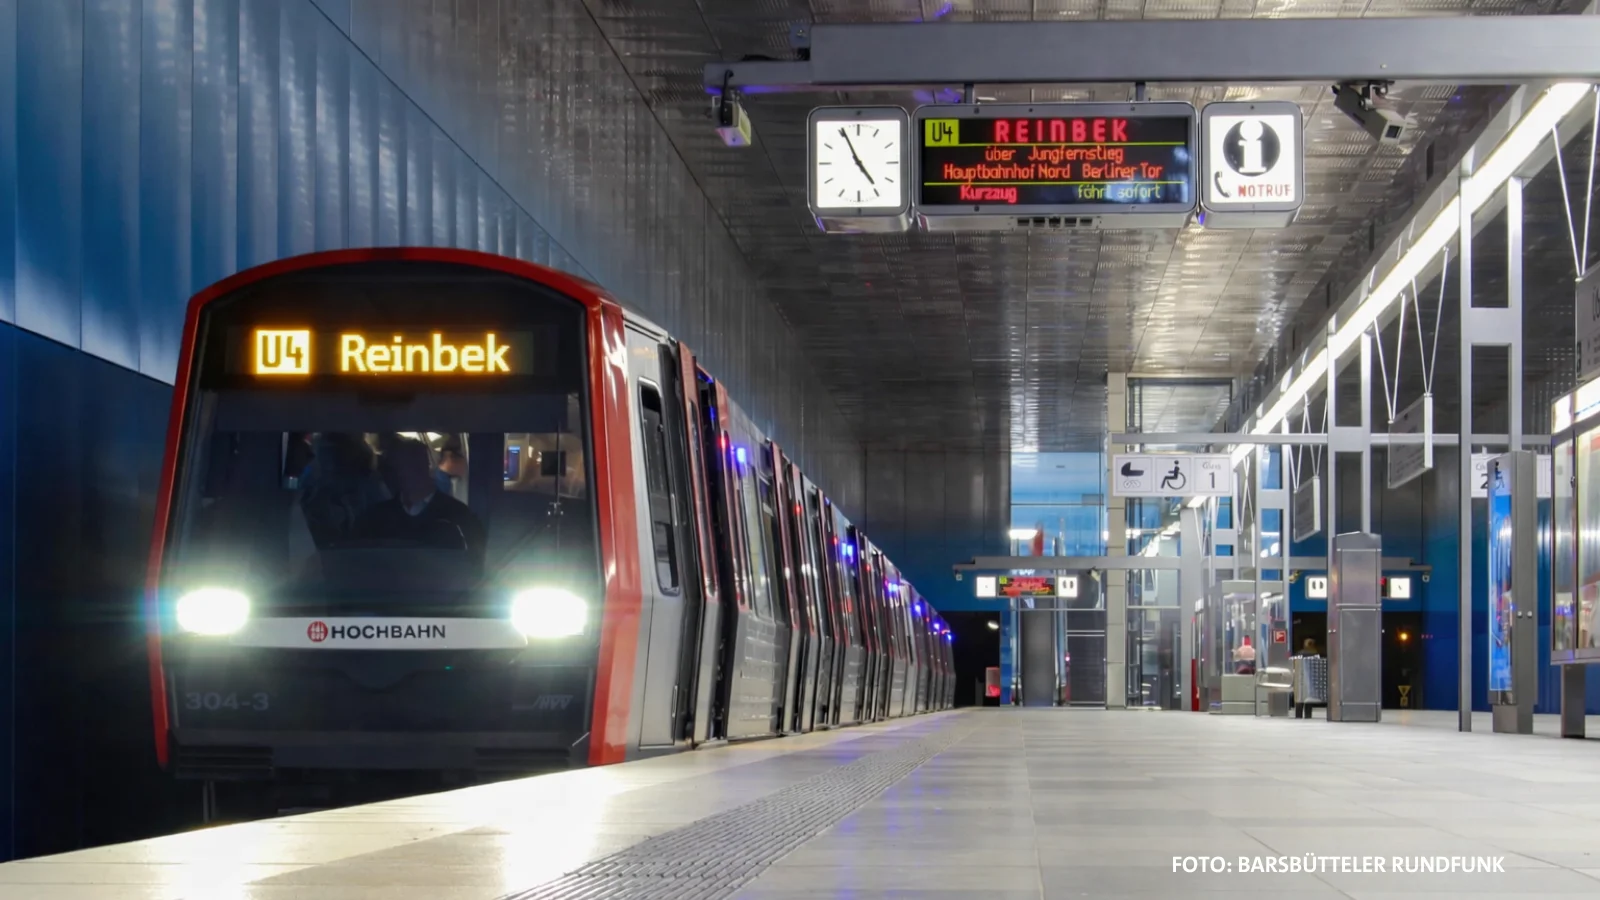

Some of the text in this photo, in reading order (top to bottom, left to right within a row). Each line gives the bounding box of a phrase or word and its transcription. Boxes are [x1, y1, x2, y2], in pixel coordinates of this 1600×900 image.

[932, 119, 1128, 143] U4 REINBEK
[985, 145, 1123, 164] über Jungfernstieg
[943, 162, 1163, 184] Hauptbahnhof Nord Berliner Tor
[960, 185, 1018, 204] Kurzzug
[1117, 184, 1162, 199] sofort
[1237, 184, 1292, 198] NOTRUF
[261, 332, 512, 373] U4 Reinbek
[1209, 471, 1216, 489] 1
[331, 624, 446, 640] HOCHBAHN
[185, 692, 269, 711] 304-3
